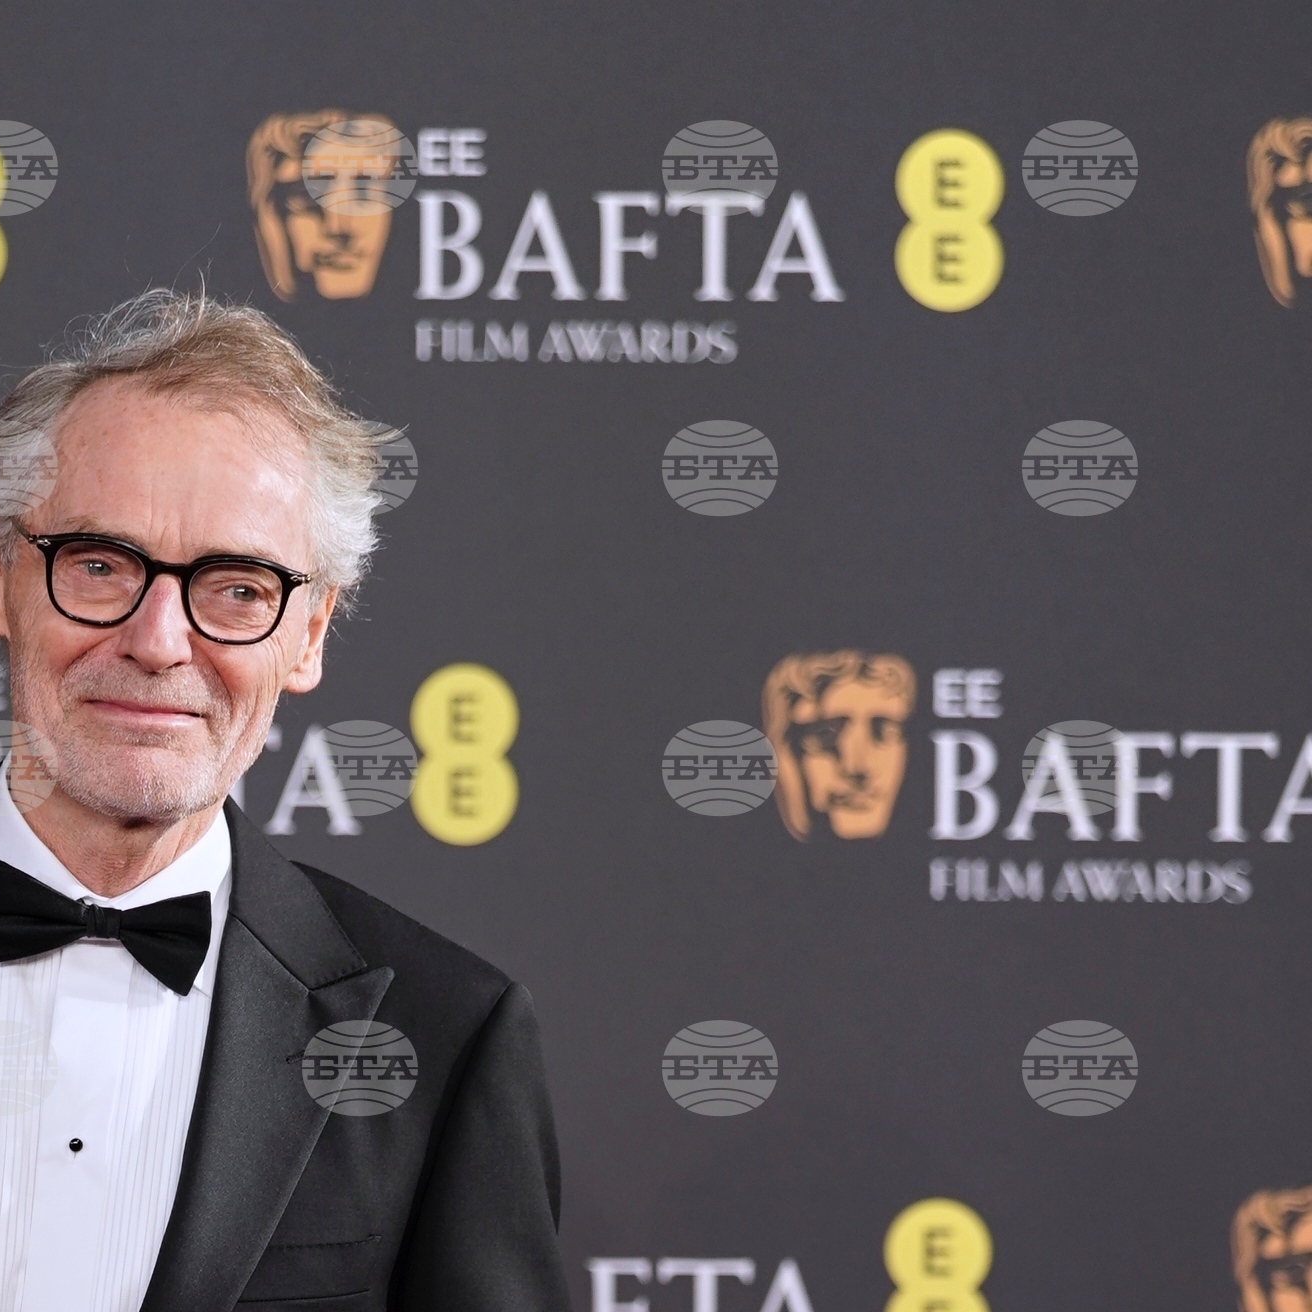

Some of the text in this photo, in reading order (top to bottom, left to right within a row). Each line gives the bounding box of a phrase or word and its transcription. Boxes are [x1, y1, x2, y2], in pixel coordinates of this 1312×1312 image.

[417, 127, 487, 177] EE
[413, 189, 846, 302] BAFTA
[415, 319, 739, 365] FILM AWARDS
[933, 667, 1004, 719] EE
[929, 856, 1254, 905] FILM AWARDS
